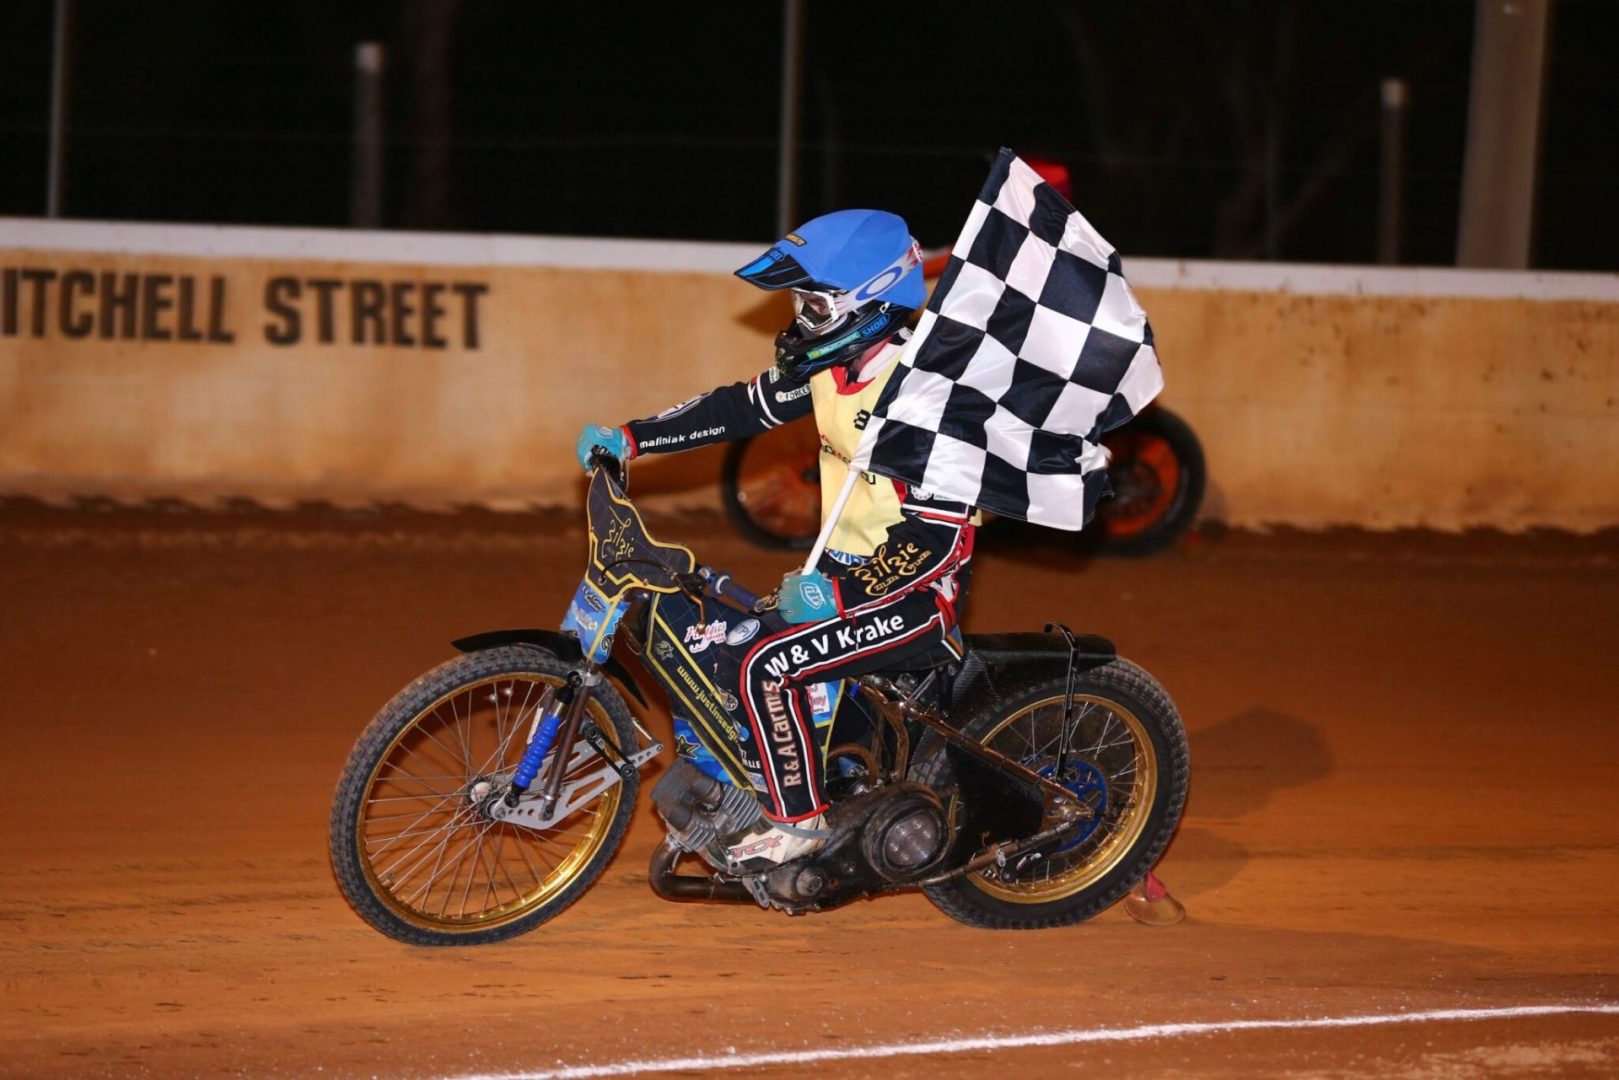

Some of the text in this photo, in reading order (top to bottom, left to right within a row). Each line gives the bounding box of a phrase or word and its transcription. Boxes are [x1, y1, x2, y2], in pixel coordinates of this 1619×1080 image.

[3, 268, 489, 349] ITCHELL STREET
[639, 425, 725, 449] maliniak design
[765, 614, 905, 677] W & V Krake
[778, 744, 798, 758] A
[784, 759, 799, 772] &
[784, 774, 802, 788] R
